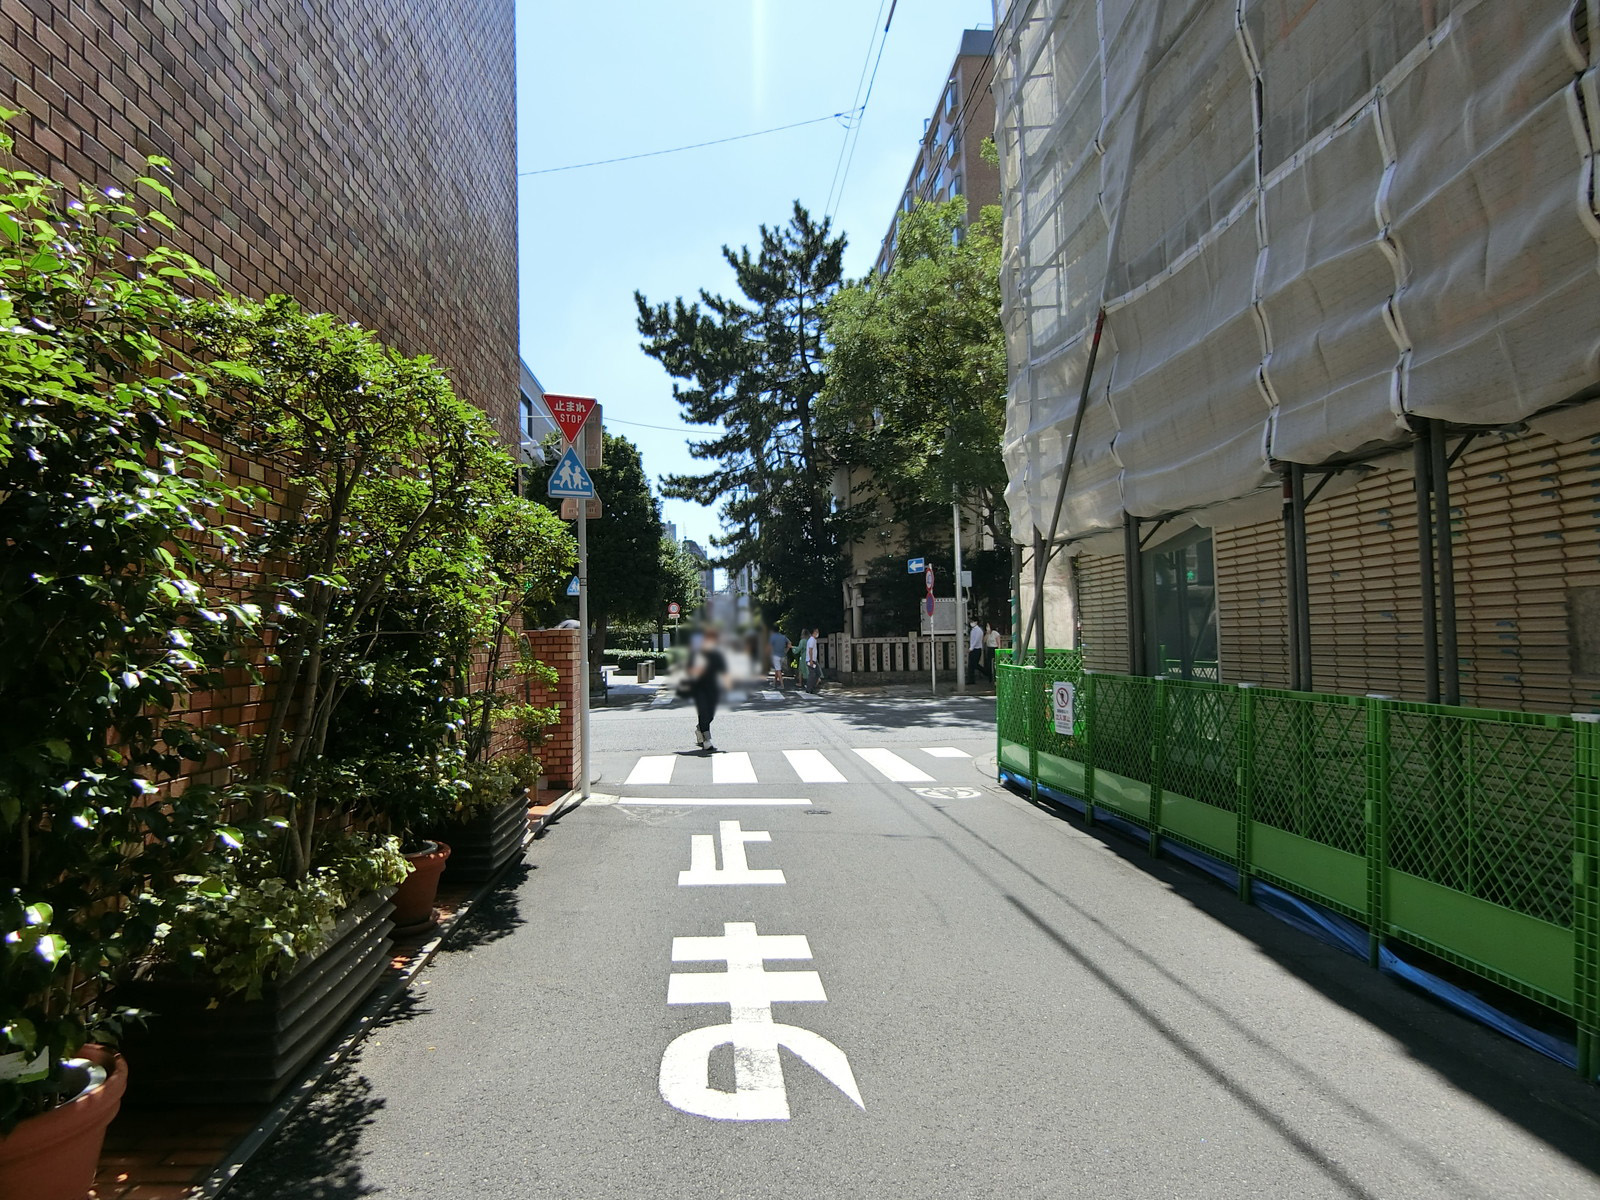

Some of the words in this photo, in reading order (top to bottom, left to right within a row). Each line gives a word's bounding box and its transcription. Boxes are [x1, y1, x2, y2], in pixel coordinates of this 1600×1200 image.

[554, 400, 586, 412] 止まれ
[560, 413, 582, 423] STOP
